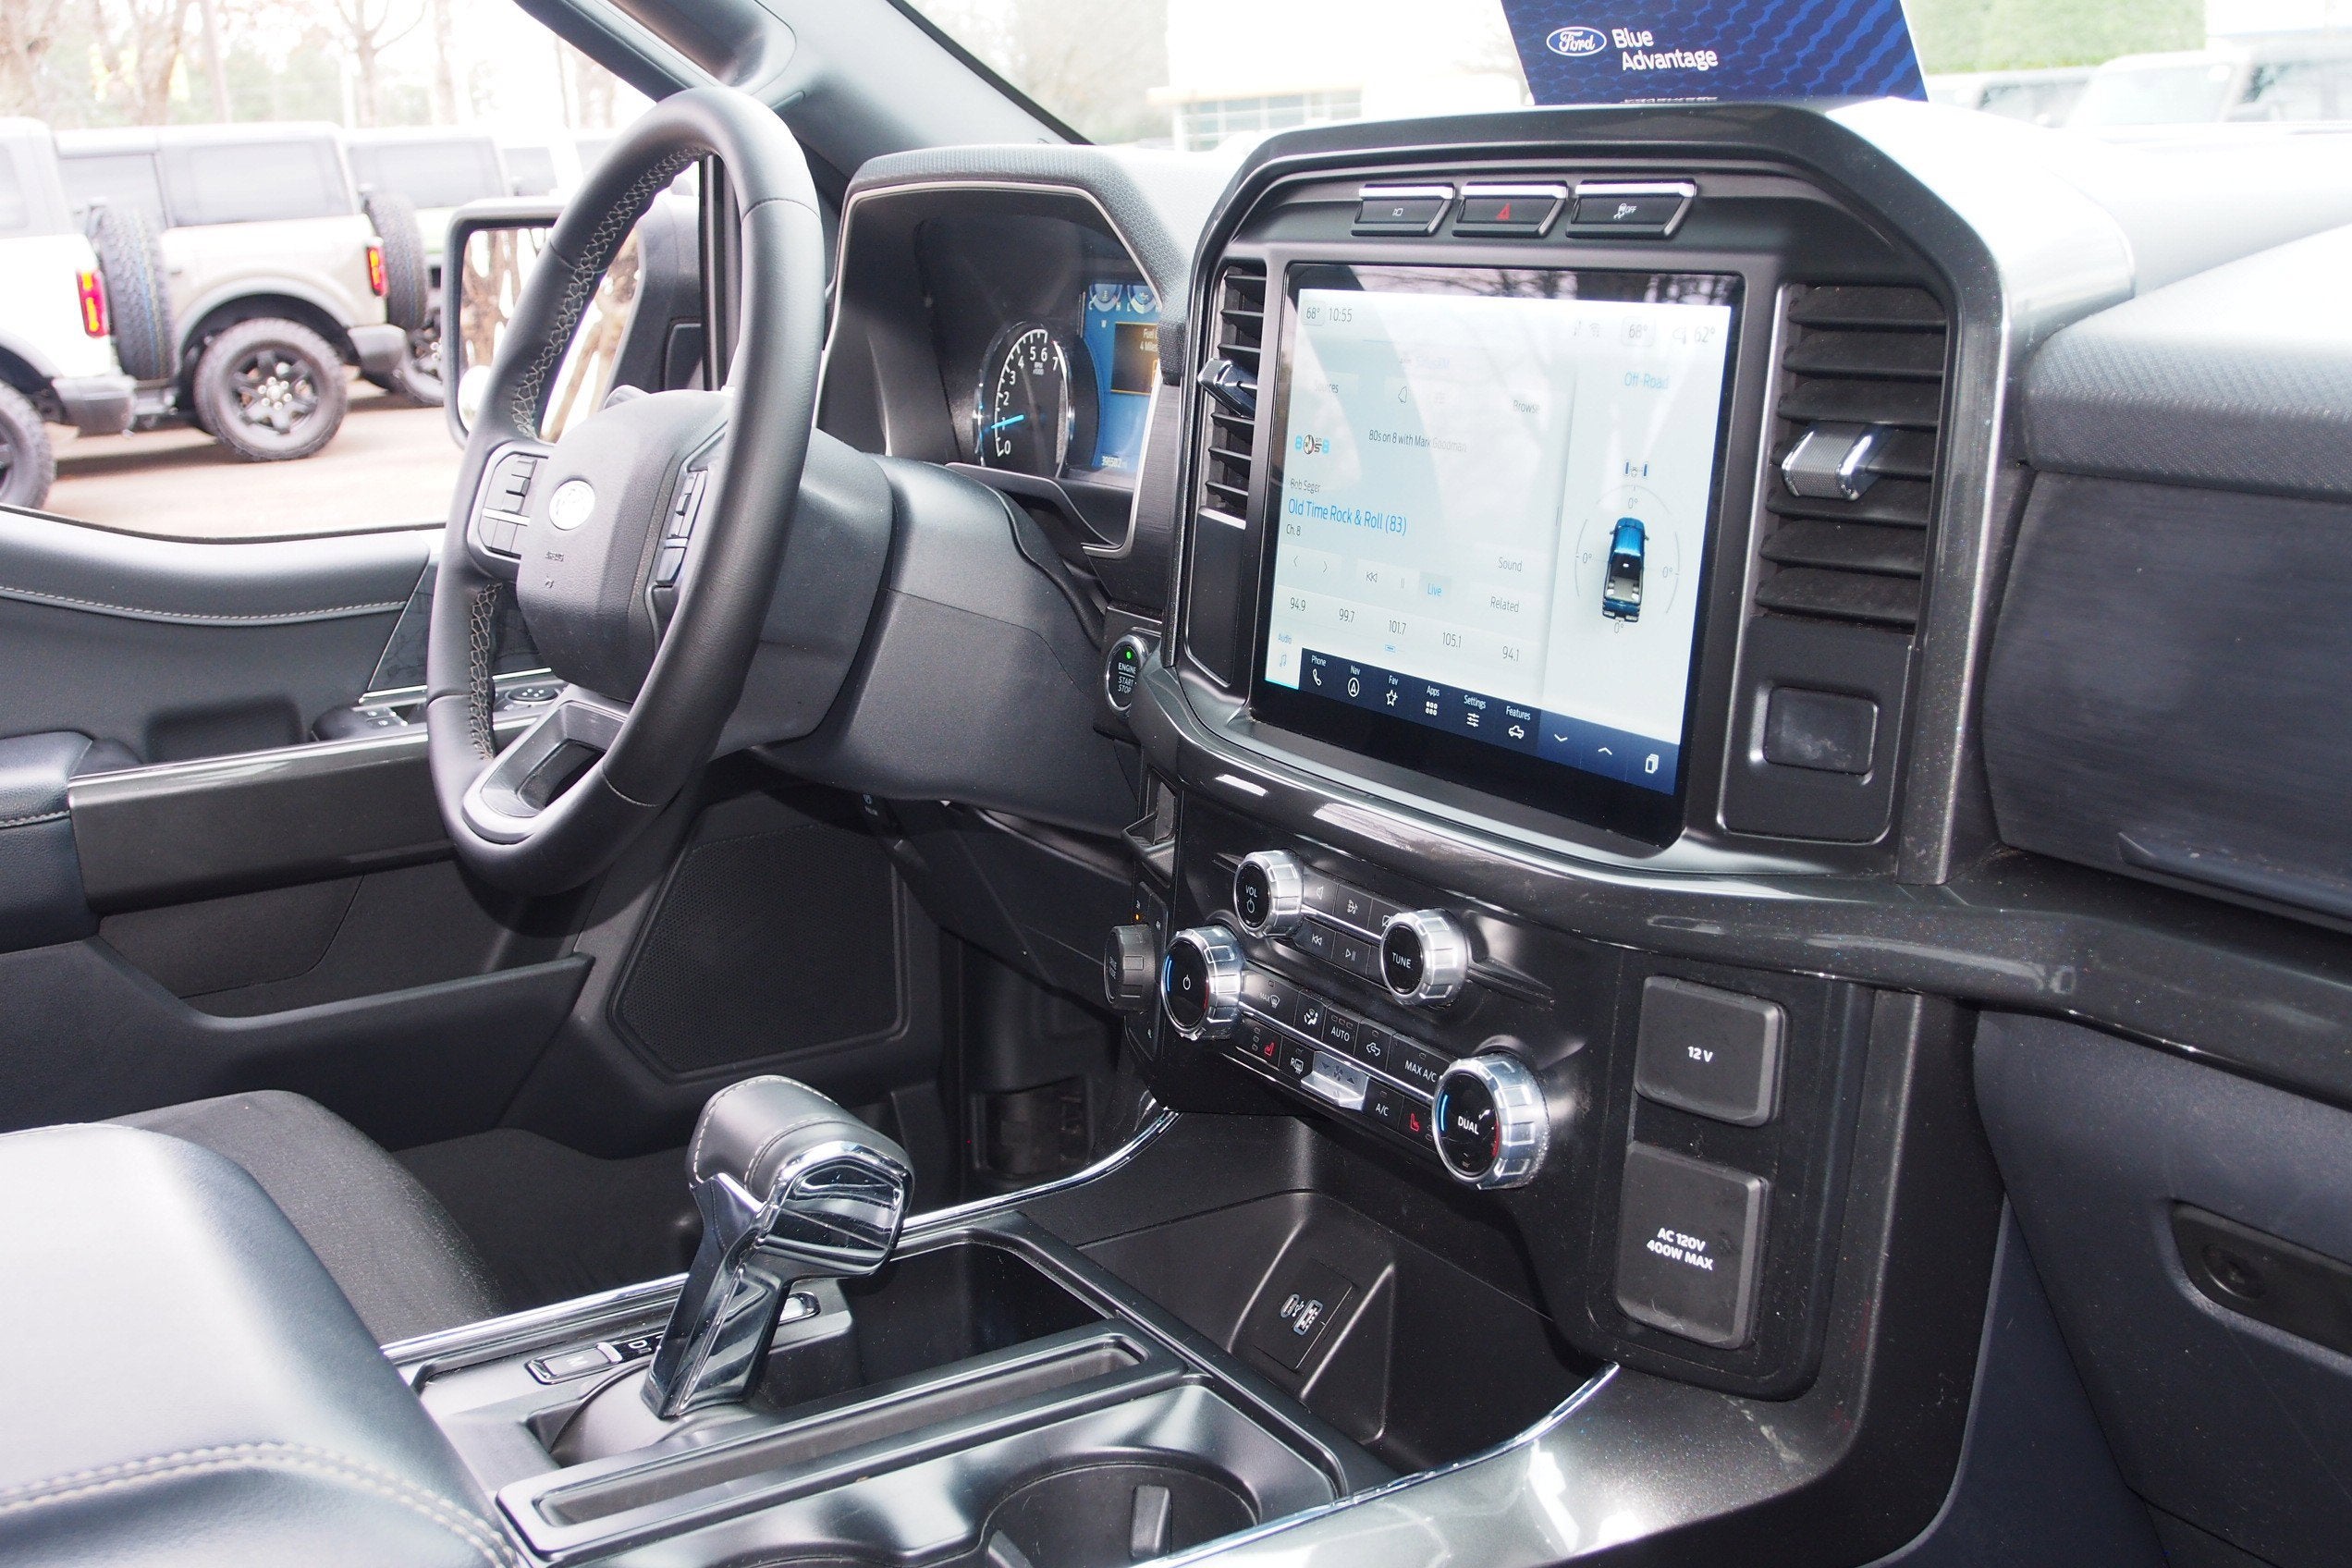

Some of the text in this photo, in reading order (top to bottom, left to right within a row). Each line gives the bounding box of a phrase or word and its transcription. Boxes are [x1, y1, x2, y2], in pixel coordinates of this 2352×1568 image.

[1559, 31, 1596, 52] Ford
[1611, 27, 1654, 49] Blue
[1622, 48, 1719, 71] Advantage
[1305, 306, 1320, 320] 68°
[1329, 307, 1353, 323] 10:55
[1030, 347, 1036, 361] 5
[1041, 347, 1047, 362] 6
[1018, 356, 1024, 369] 4
[1052, 356, 1059, 372] 7
[1010, 370, 1016, 385] 3
[1624, 372, 1670, 390] Off-Road
[1003, 390, 1010, 406] 2
[1004, 440, 1011, 455] 0
[1368, 429, 1467, 453] 80s on 8 with Mark Goodman
[1290, 478, 1321, 494] Bob Seger
[1288, 498, 1407, 536] Old Time Rock & Roll (83)
[1296, 525, 1302, 536] 8
[1498, 557, 1523, 572] Sound
[1427, 582, 1442, 596] Live
[1490, 596, 1520, 613] Related
[1290, 597, 1520, 662] 94.9 99.7 101.7 105.1 94.1
[1278, 632, 1292, 644] Audio
[1118, 662, 1137, 675] ENGINE
[1311, 655, 1327, 668] Phone
[1350, 665, 1361, 676] Nav
[1118, 676, 1134, 686] START
[1388, 675, 1399, 686] Fav
[1117, 684, 1132, 694] STOP
[1426, 685, 1440, 697] Apps
[1464, 694, 1487, 710] Settings
[1505, 705, 1531, 721] Features
[1245, 885, 1257, 898] VOL
[1391, 951, 1412, 970] TUNE
[1258, 992, 1271, 1002] MAX
[1330, 1025, 1350, 1043] AUTO
[1687, 1046, 1714, 1063] 12 V
[1404, 1060, 1437, 1083] MAX A/C
[1375, 1103, 1390, 1117] A/C
[1457, 1115, 1479, 1135] DUAL
[1657, 1227, 1707, 1252] AC 120V
[1646, 1239, 1714, 1271] 400W MAX
